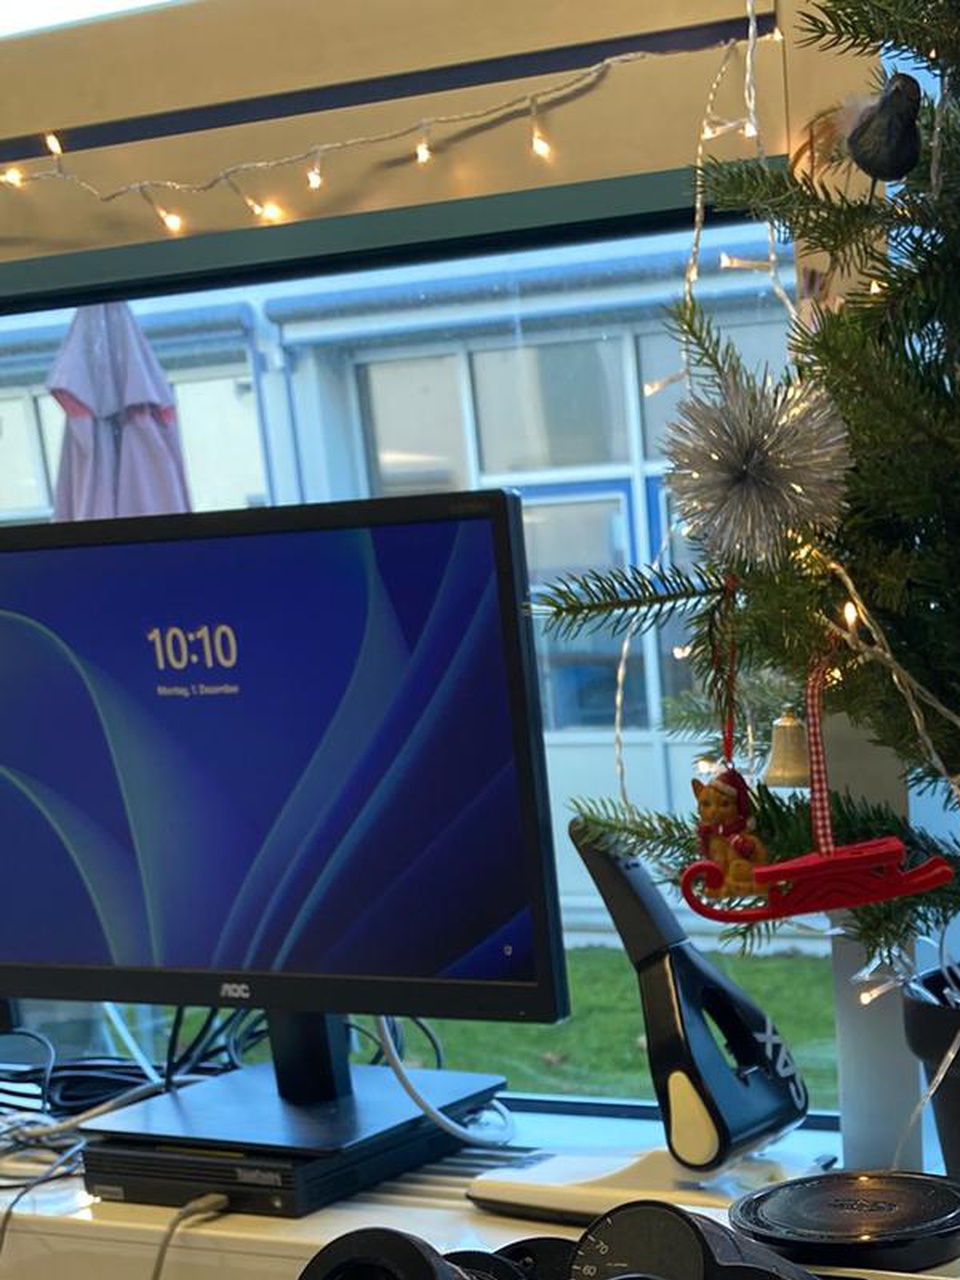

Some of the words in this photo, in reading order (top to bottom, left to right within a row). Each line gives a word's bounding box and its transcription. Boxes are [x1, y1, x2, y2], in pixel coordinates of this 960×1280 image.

[147, 624, 238, 670] 10:10
[220, 983, 250, 998] AOC
[582, 1264, 597, 1276] 60
